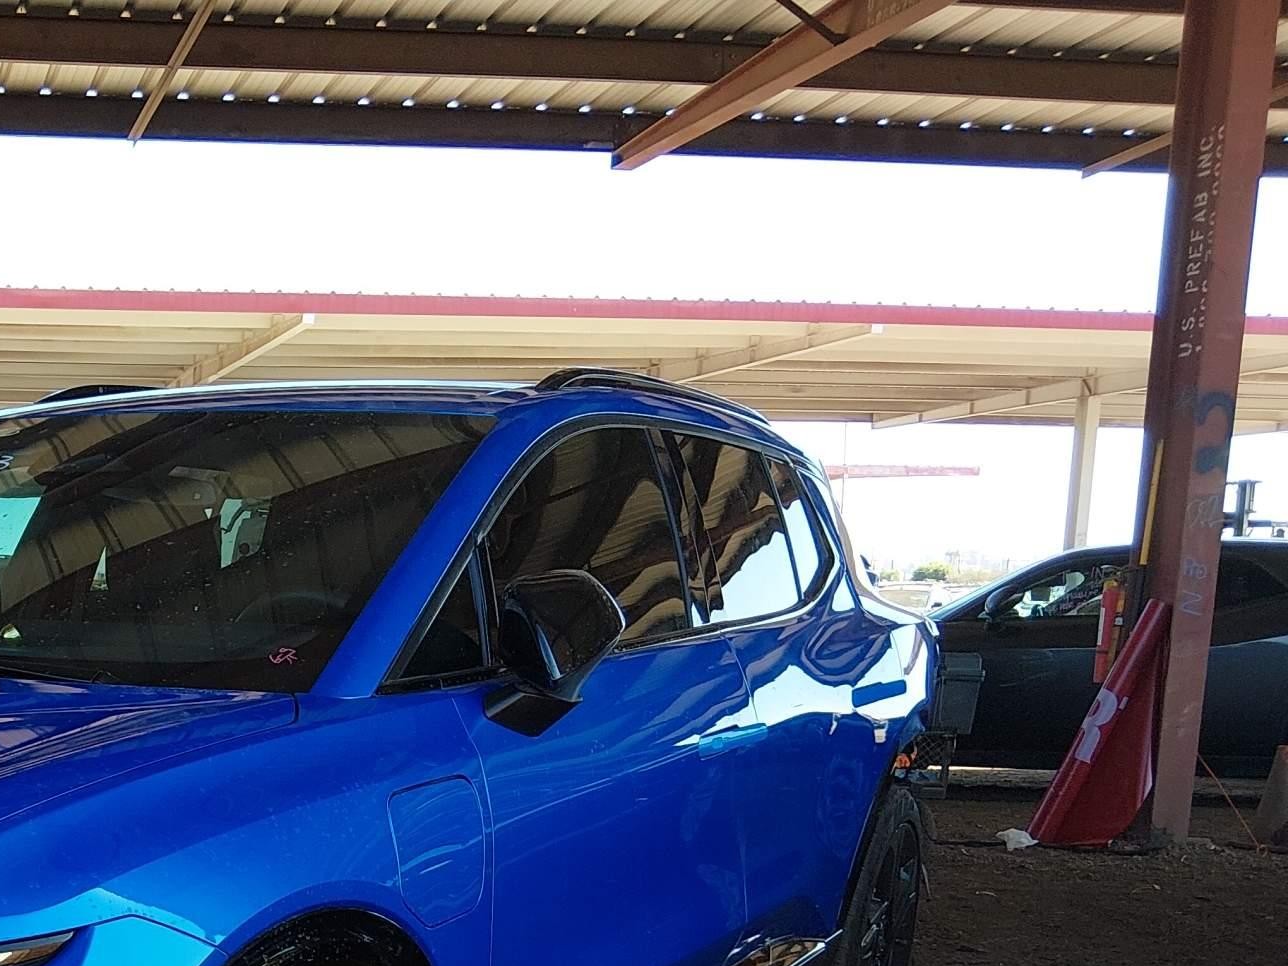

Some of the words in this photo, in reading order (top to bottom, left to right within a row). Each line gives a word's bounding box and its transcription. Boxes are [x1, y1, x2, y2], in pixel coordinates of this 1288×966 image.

[1197, 126, 1216, 177] INC.
[1184, 192, 1209, 293] PREFAB
[1177, 307, 1197, 358] U.S.
